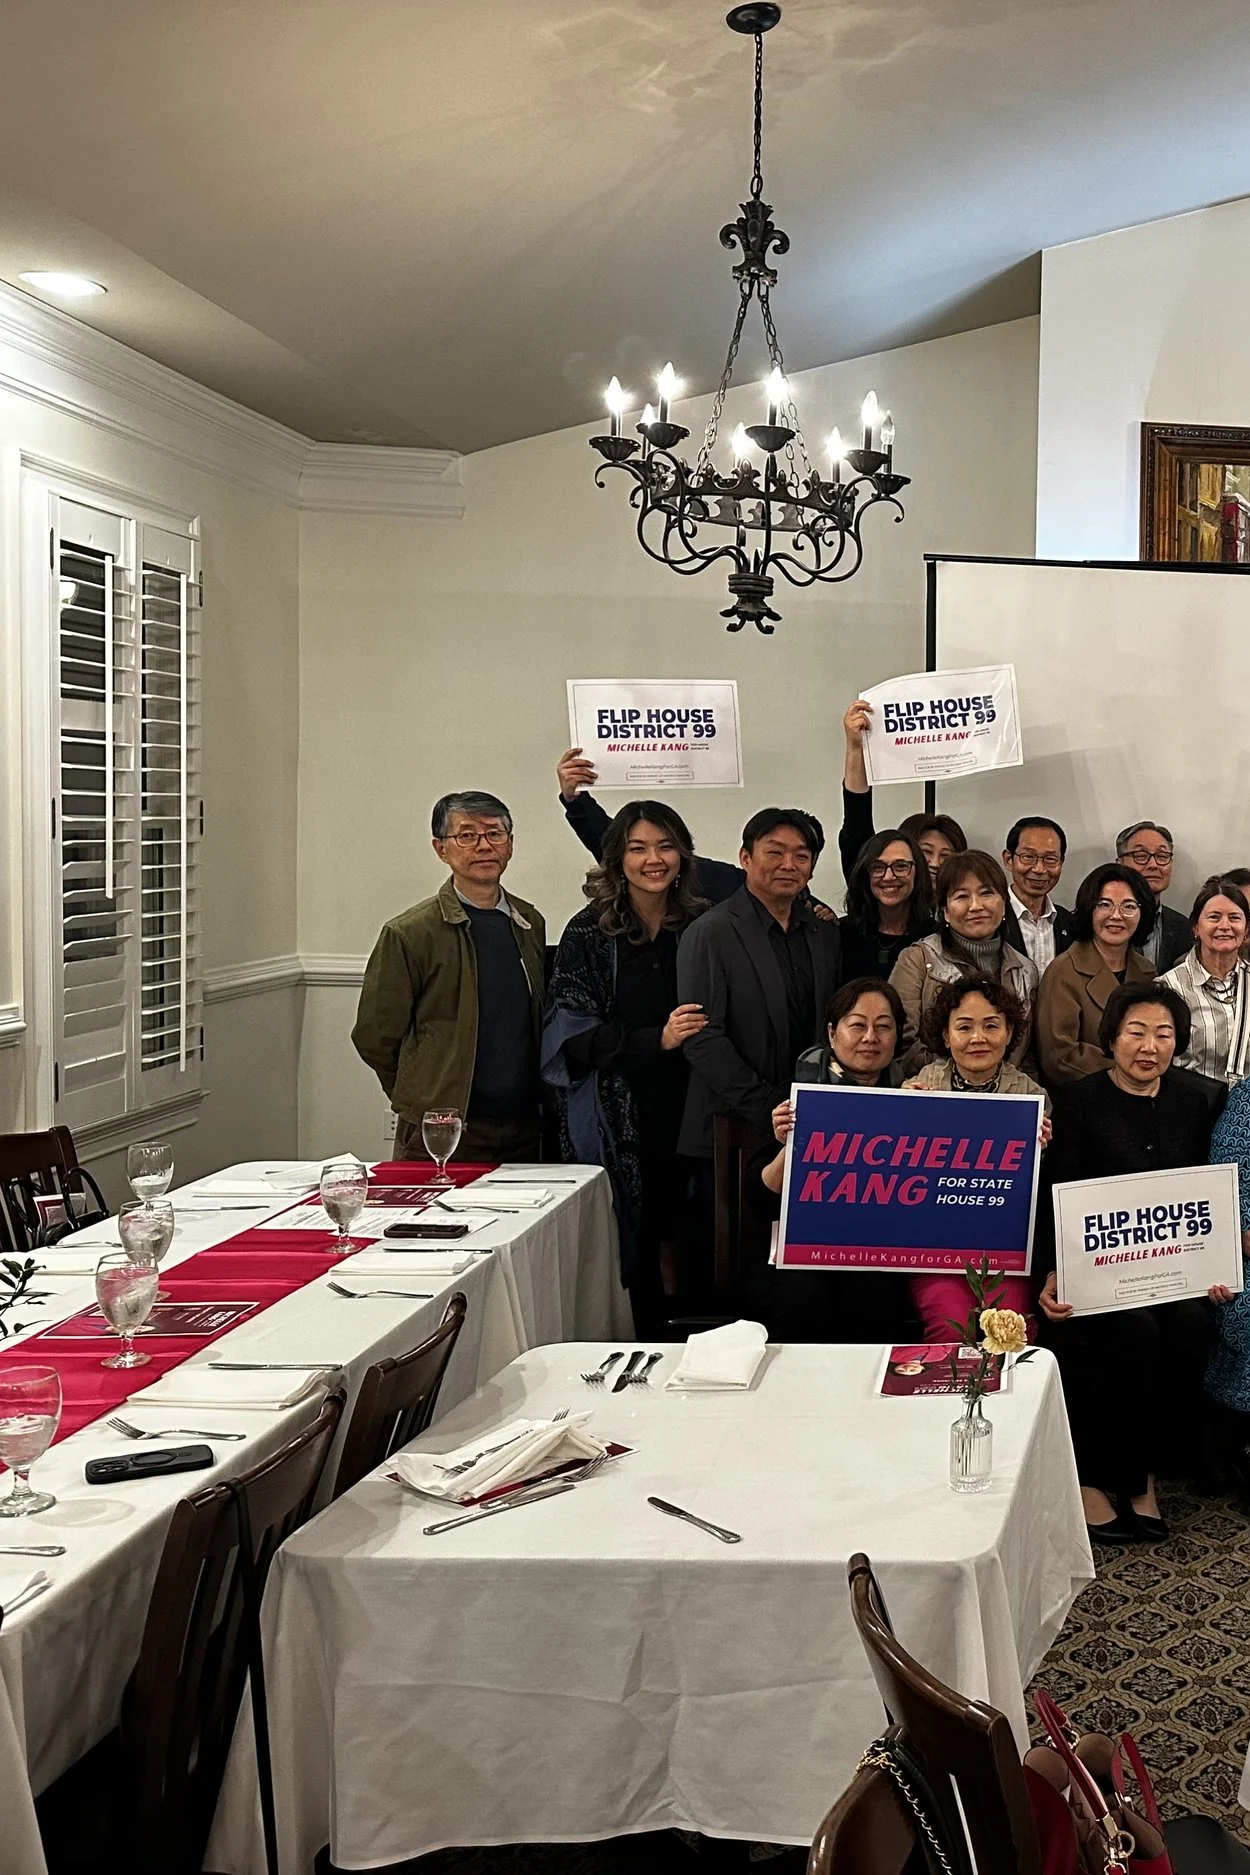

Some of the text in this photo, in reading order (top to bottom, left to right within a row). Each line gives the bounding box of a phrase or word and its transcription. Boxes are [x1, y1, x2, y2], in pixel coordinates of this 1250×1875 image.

[597, 709, 714, 723] FLIP HOUSE
[883, 695, 994, 718] FLIP HOUSE
[597, 724, 716, 739] DISTRICT 99
[884, 709, 997, 733] DISTRICT 99
[607, 744, 658, 752] MICHELLE
[661, 743, 689, 751] KANG
[894, 734, 942, 746] MICHELLE
[802, 1131, 1027, 1171] MICHELLE
[799, 1170, 929, 1206] KANG
[937, 1177, 1014, 1190] FOR STATE
[936, 1194, 1005, 1206] HOUSE 99
[1084, 1200, 1210, 1233] FLIP HOUSE
[1084, 1218, 1212, 1252] DISTRICT 99
[1094, 1244, 1182, 1267] MICHELLE KANG
